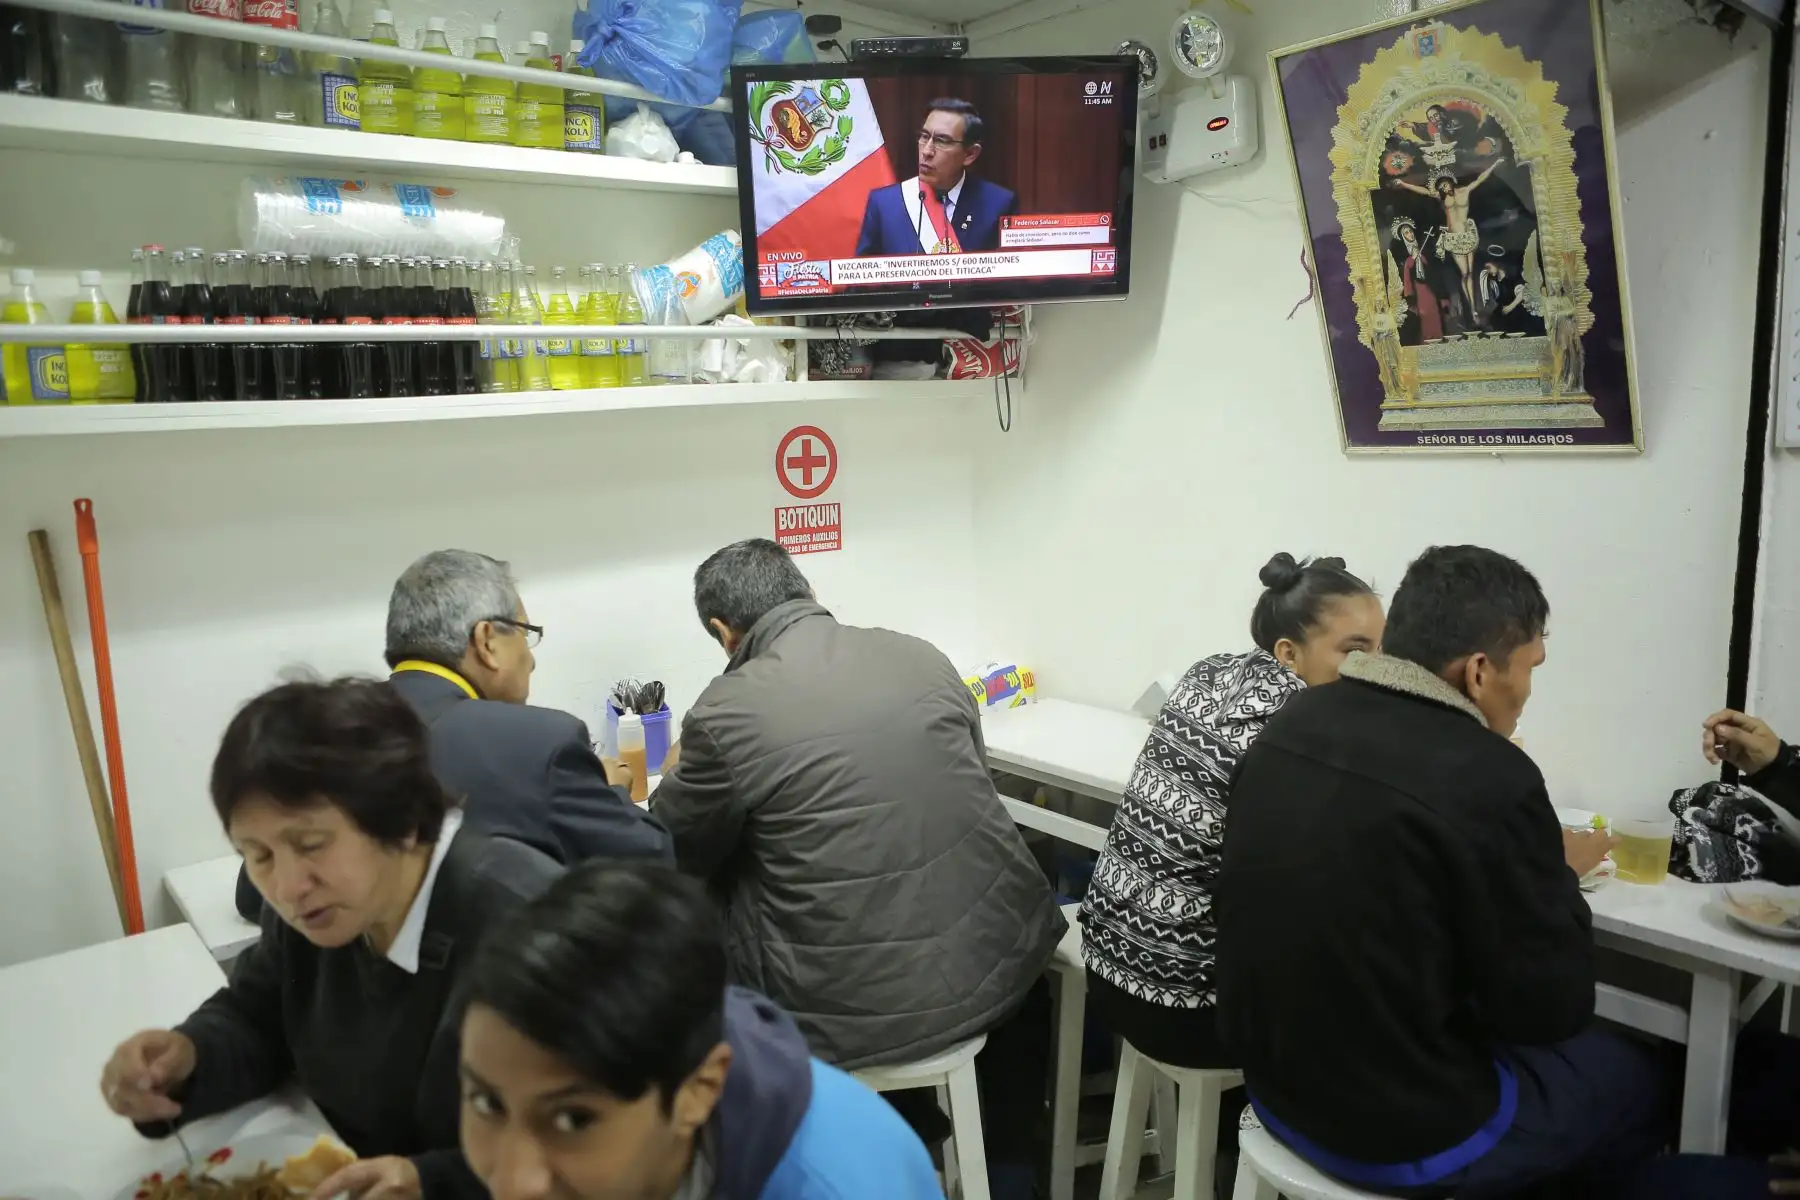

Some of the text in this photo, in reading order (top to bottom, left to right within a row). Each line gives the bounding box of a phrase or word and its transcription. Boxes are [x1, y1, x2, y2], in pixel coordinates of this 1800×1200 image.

[767, 251, 803, 261] EN VIVO
[784, 260, 822, 279] Fiesta
[838, 262, 882, 271] VIZCARRA:
[951, 257, 960, 266] S/
[962, 257, 978, 265] 600
[979, 255, 1020, 264] MILLONES
[838, 272, 862, 280] PARA
[863, 271, 873, 279] LA
[875, 267, 937, 279] PRESERVACIÓN
[938, 268, 954, 276] DEL
[1417, 434, 1574, 444] SEÑOR DE LOS MILAGROS
[779, 504, 839, 530] BOTIQUIN
[780, 531, 839, 545] PRIMEROS AUXILIOS
[788, 545, 800, 553] CASO
[809, 541, 837, 551] EMERGENCIA
